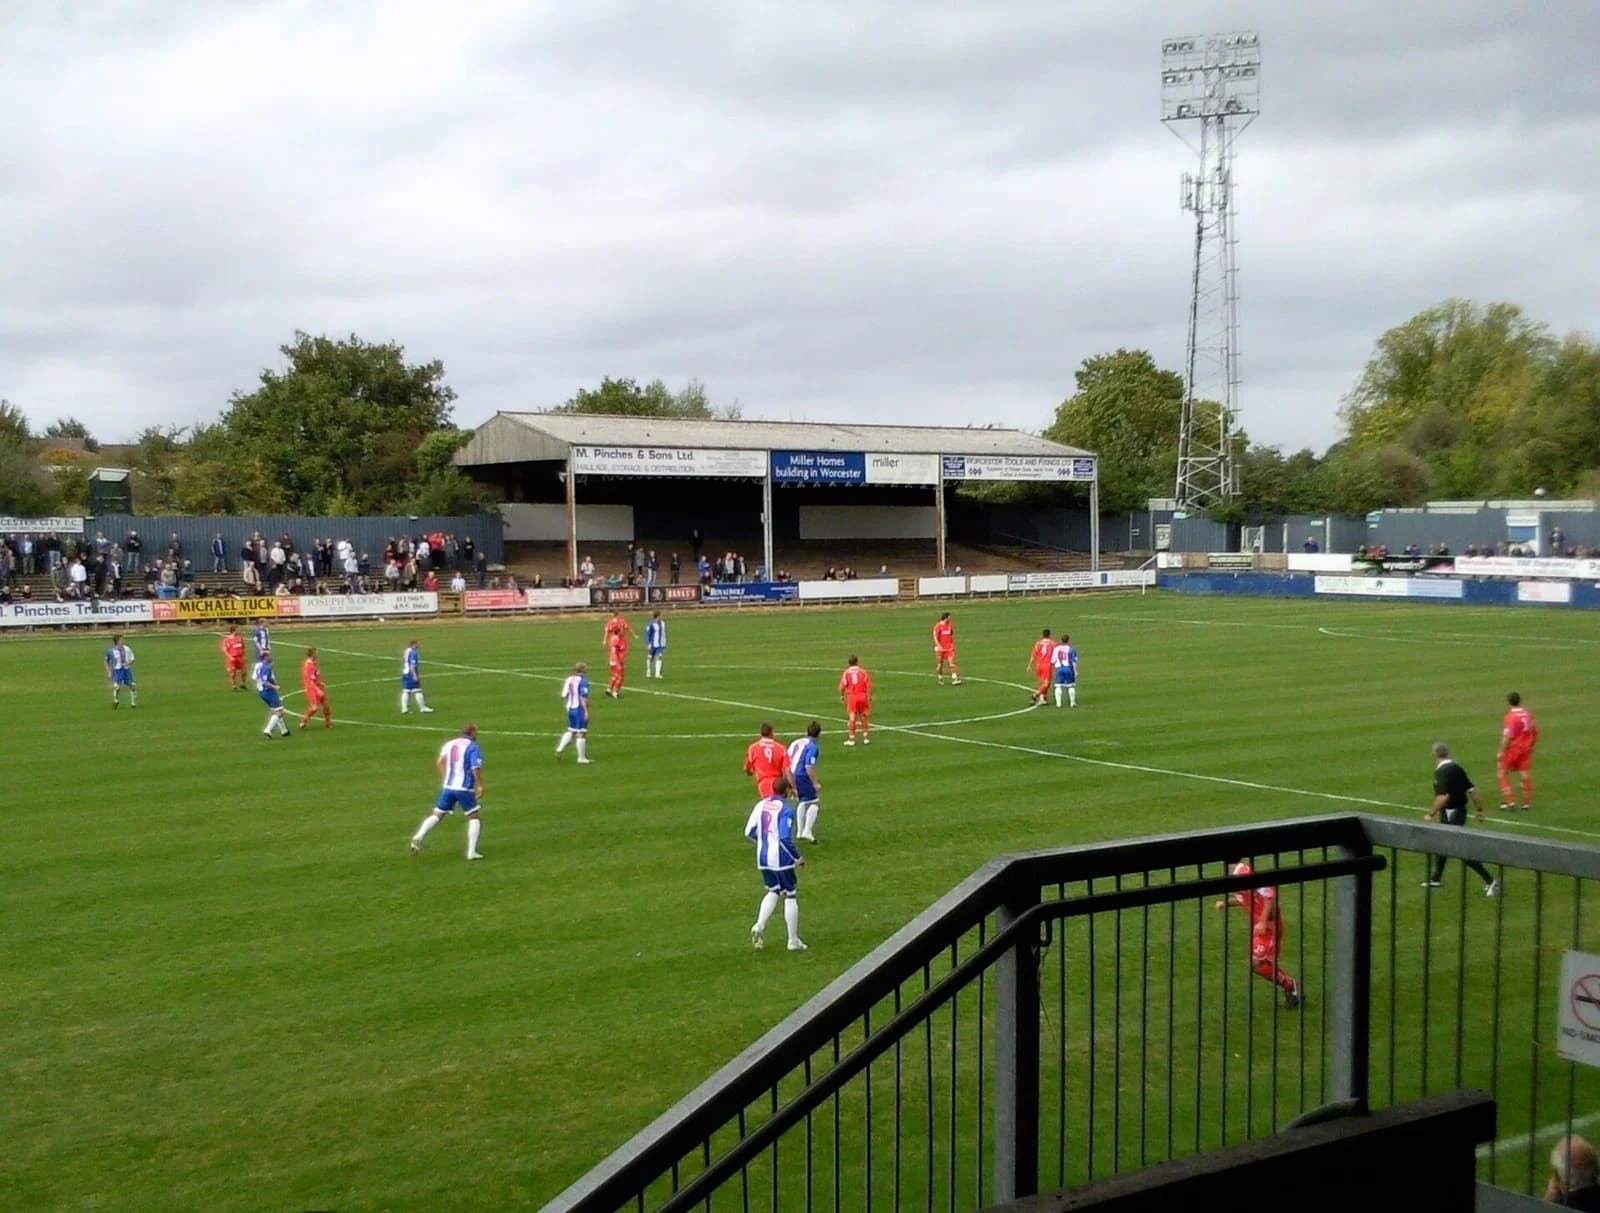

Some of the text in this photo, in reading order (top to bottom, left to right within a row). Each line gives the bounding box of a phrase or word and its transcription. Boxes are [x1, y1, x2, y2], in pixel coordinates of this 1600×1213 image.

[576, 448, 588, 458] M.
[594, 448, 633, 459] Pinches
[648, 450, 673, 460] Sons
[677, 451, 696, 460] Ltd.
[790, 455, 845, 466] Miller Homes
[872, 457, 899, 468] miller
[966, 457, 1003, 465] WORCESTER
[1005, 457, 1023, 465] TOOLS
[775, 466, 808, 479] building
[810, 467, 817, 477] in
[821, 468, 861, 479] Worcester
[15, 605, 70, 616] Pinches
[180, 600, 238, 612] MICHAEL
[240, 598, 274, 610] TUCK
[764, 747, 773, 764] 9
